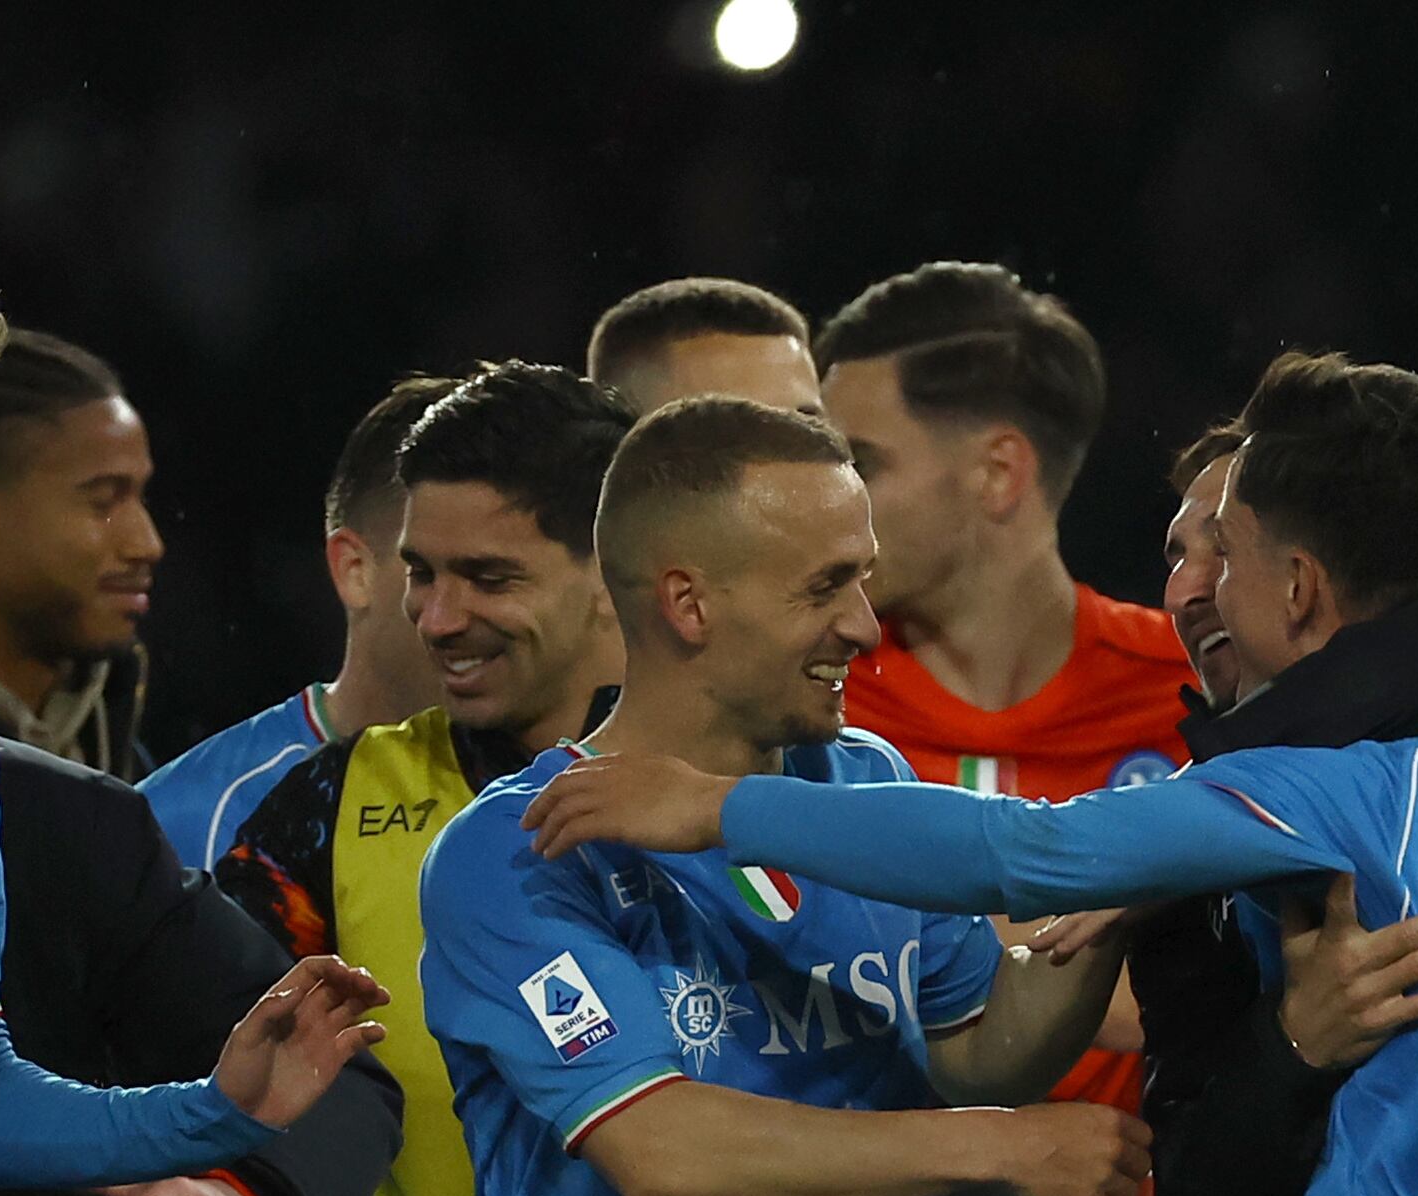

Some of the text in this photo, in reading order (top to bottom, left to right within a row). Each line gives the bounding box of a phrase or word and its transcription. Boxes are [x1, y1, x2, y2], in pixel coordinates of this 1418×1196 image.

[358, 798, 439, 838] EA7
[609, 862, 683, 909] EA
[554, 1011, 587, 1036] SERIE
[580, 1024, 611, 1047] TIM
